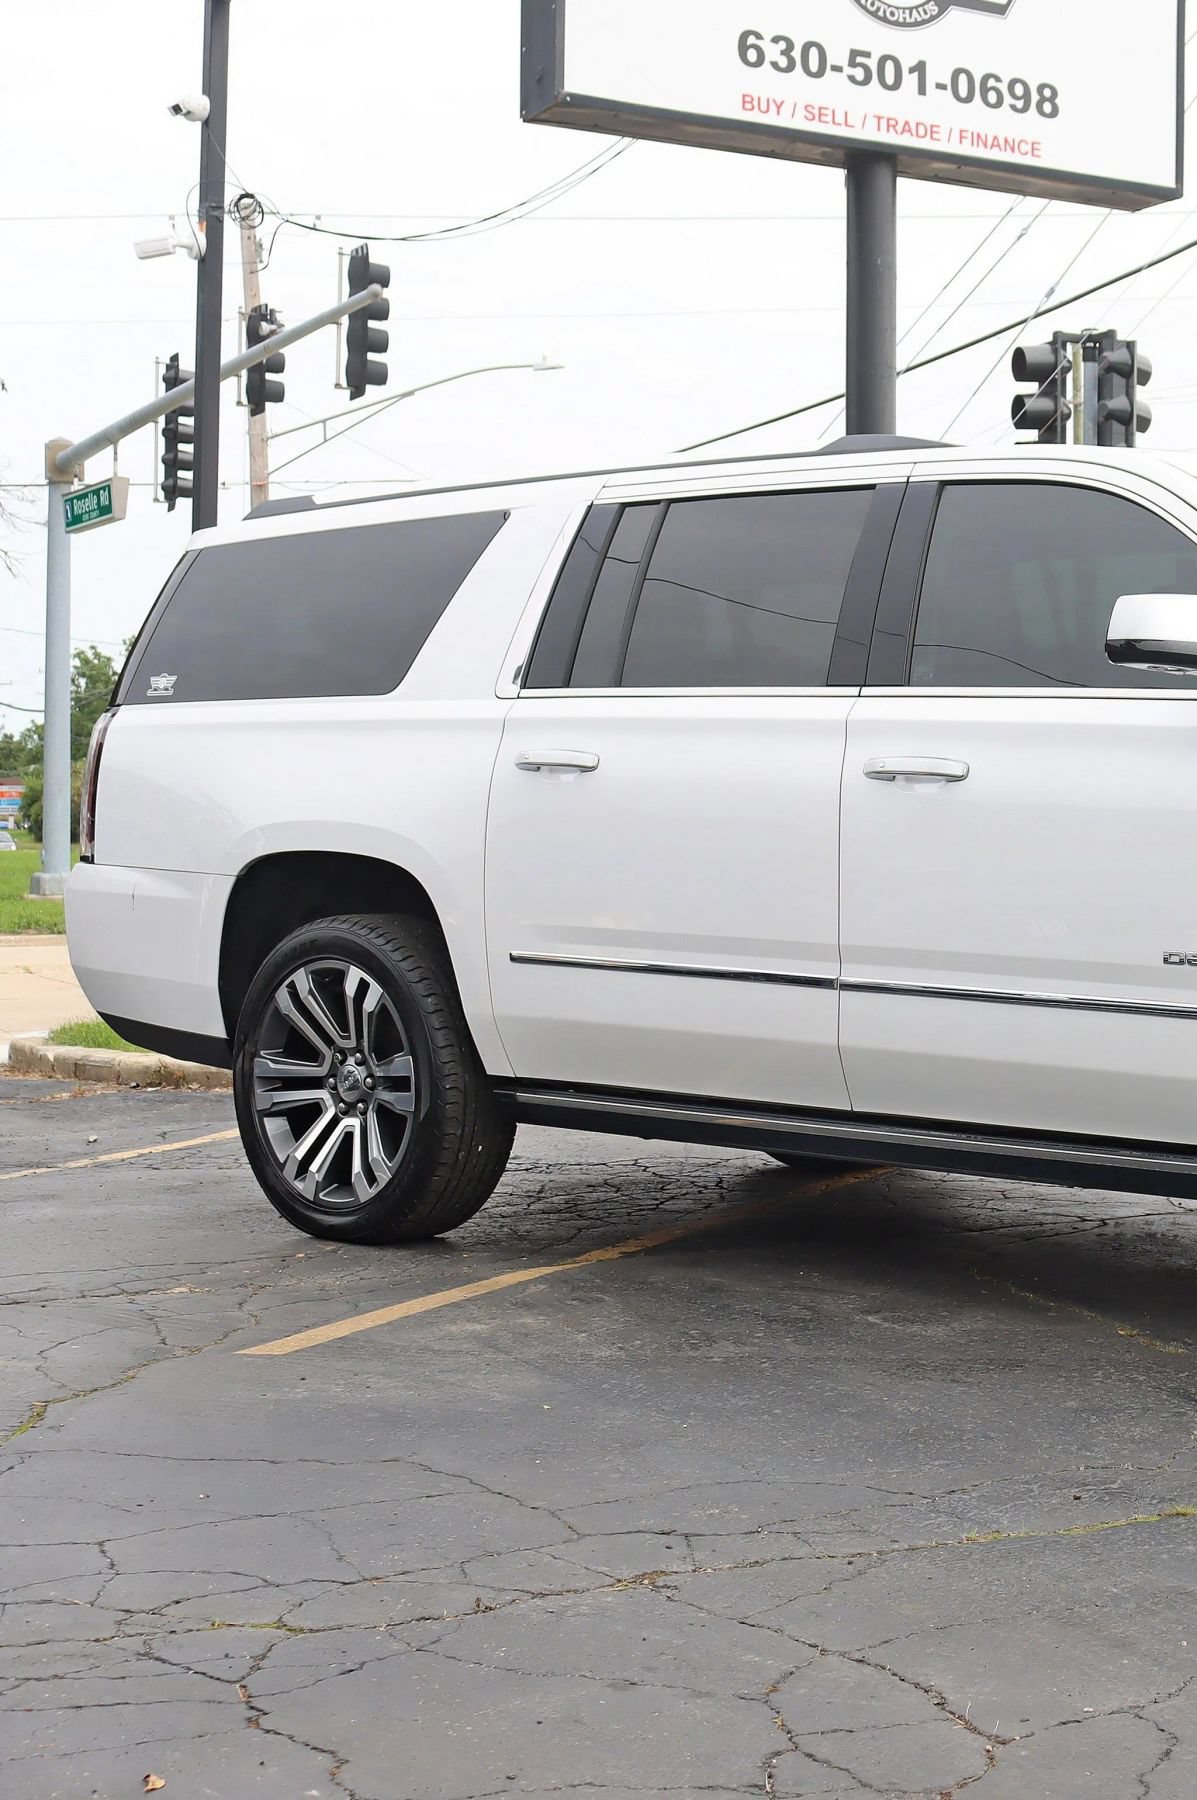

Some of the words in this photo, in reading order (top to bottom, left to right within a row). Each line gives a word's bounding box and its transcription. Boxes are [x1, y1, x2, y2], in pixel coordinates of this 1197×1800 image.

[737, 29, 1060, 119] 630-501-0698
[741, 94, 785, 117] BUY
[804, 103, 856, 129] SELL
[873, 114, 941, 142] TRADE
[958, 129, 1043, 158] FINANCE
[73, 492, 98, 516] Roselle
[100, 486, 109, 507] Rd
